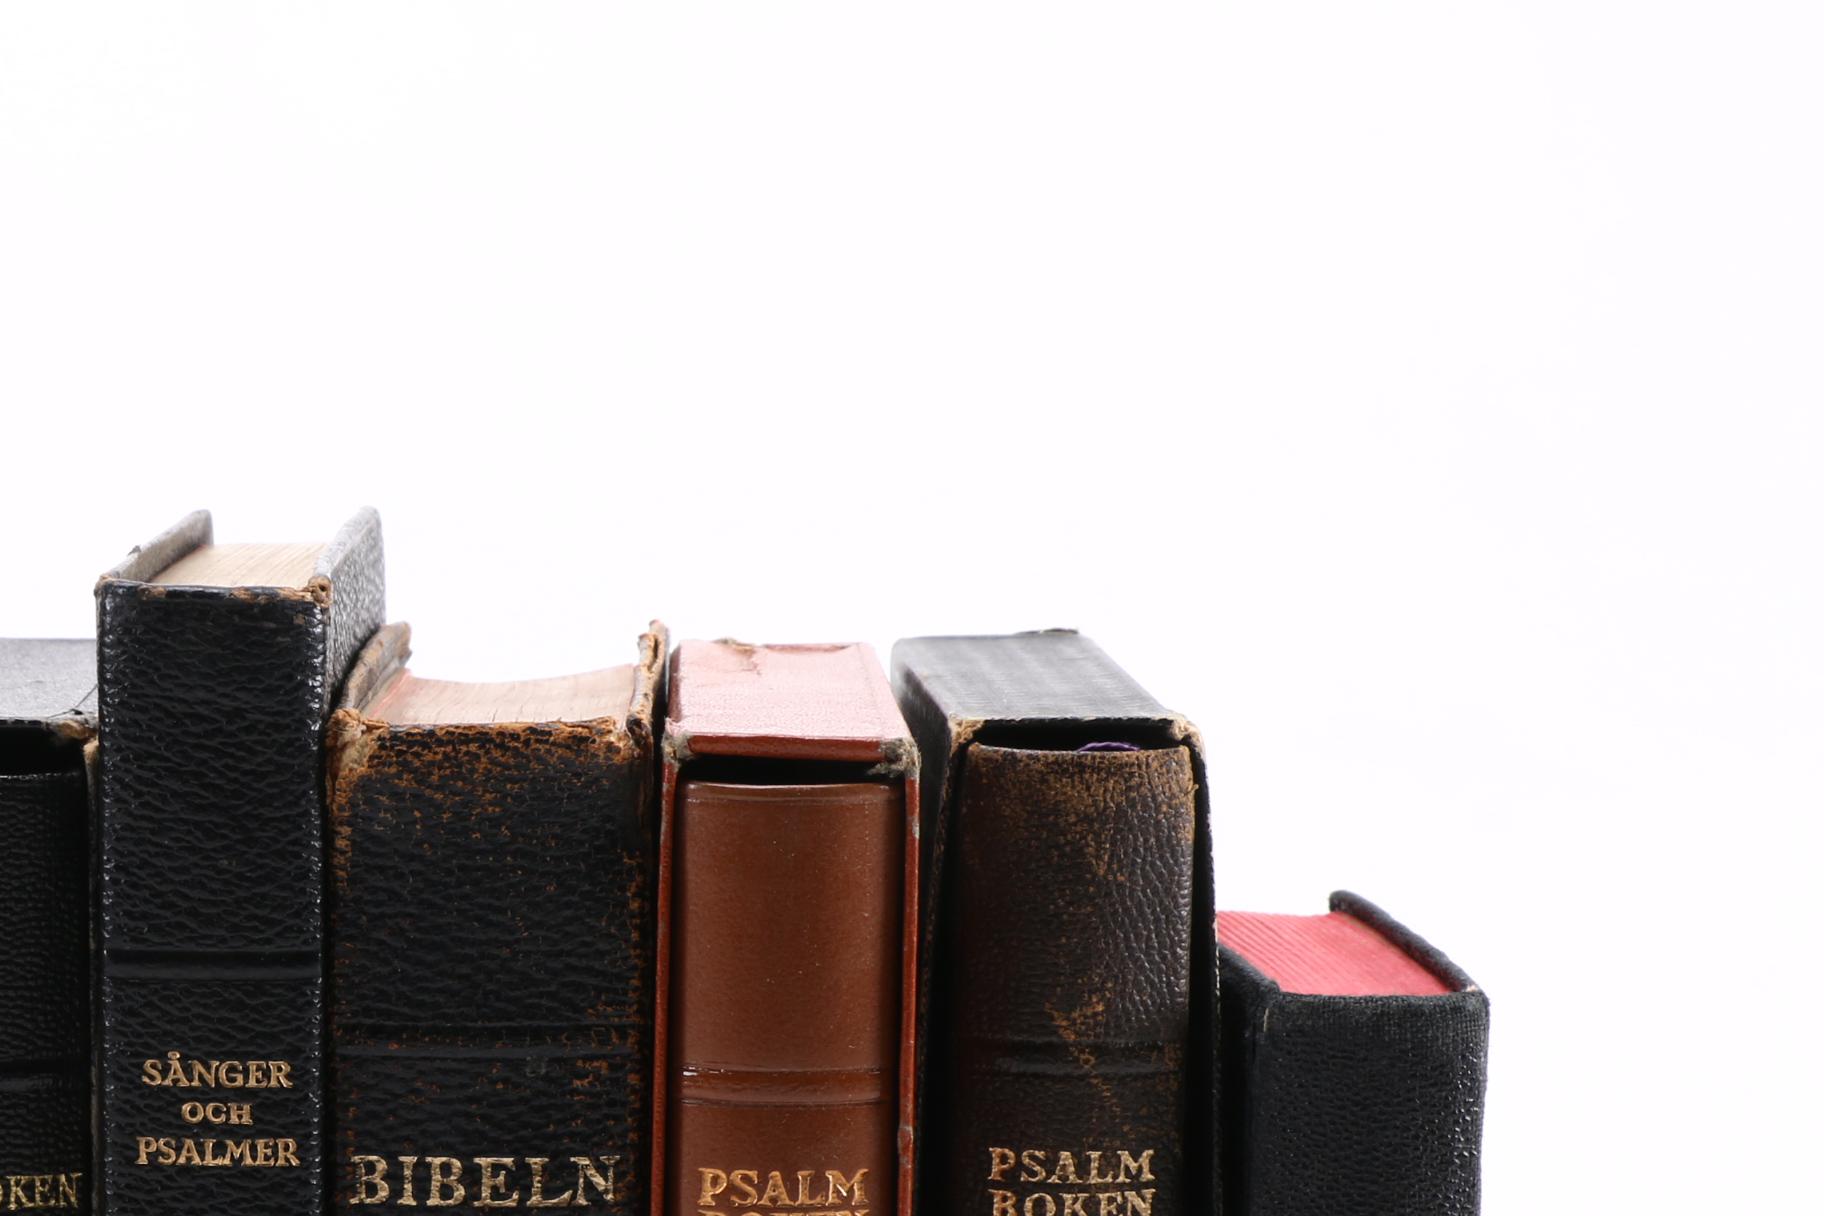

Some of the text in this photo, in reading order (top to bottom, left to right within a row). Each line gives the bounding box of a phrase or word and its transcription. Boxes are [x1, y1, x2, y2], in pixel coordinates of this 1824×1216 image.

[141, 1050, 294, 1090] SÅNGER
[180, 1100, 255, 1126] OCH
[134, 1135, 302, 1168] PSALMER
[986, 1146, 1157, 1185] PSALM
[348, 1154, 622, 1208] BIBELN
[697, 1166, 870, 1208] PSALM
